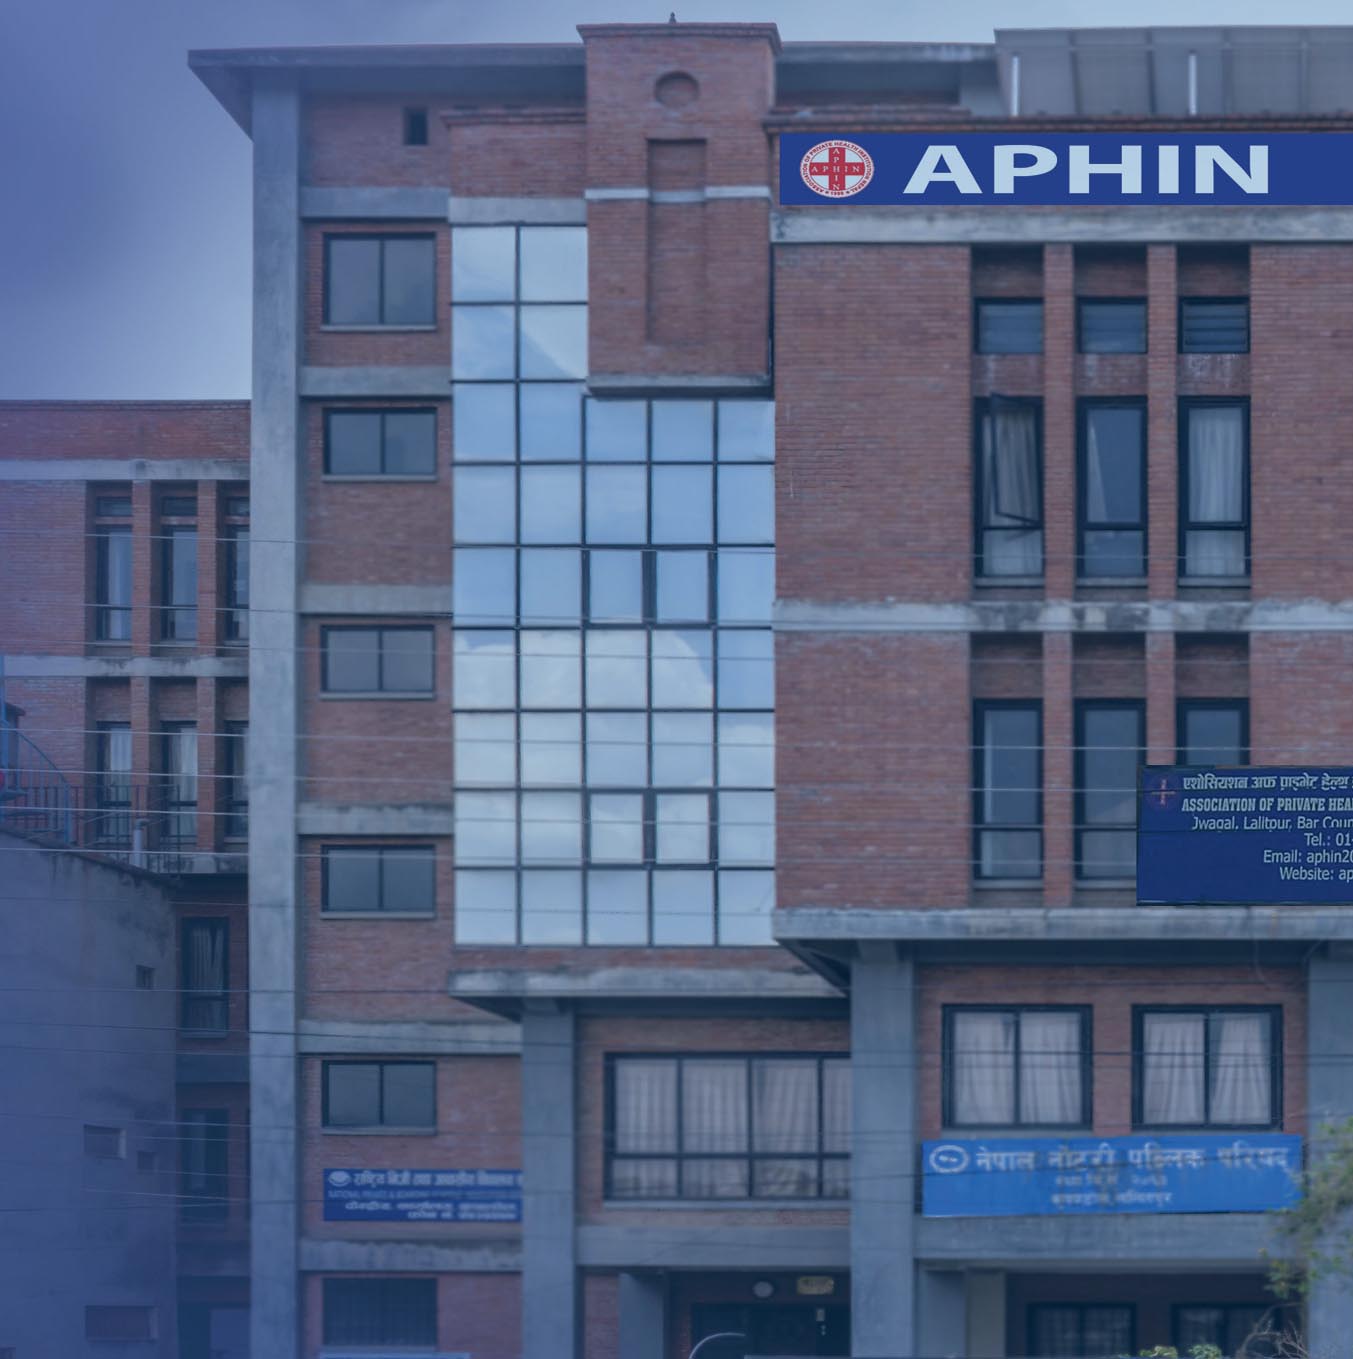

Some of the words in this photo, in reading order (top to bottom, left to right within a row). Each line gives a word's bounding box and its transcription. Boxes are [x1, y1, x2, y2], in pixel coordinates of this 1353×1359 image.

[903, 144, 1269, 194] APHIN
[1251, 776, 1277, 788] अफ
[1182, 798, 1256, 811] ASSOCIATION
[1259, 798, 1274, 811] OF
[1277, 798, 1325, 811] PRIVATE
[1298, 816, 1319, 829] Bar
[1264, 849, 1301, 863] Email:
[1280, 867, 1333, 880] Website:
[975, 1145, 1035, 1171] नेपाल
